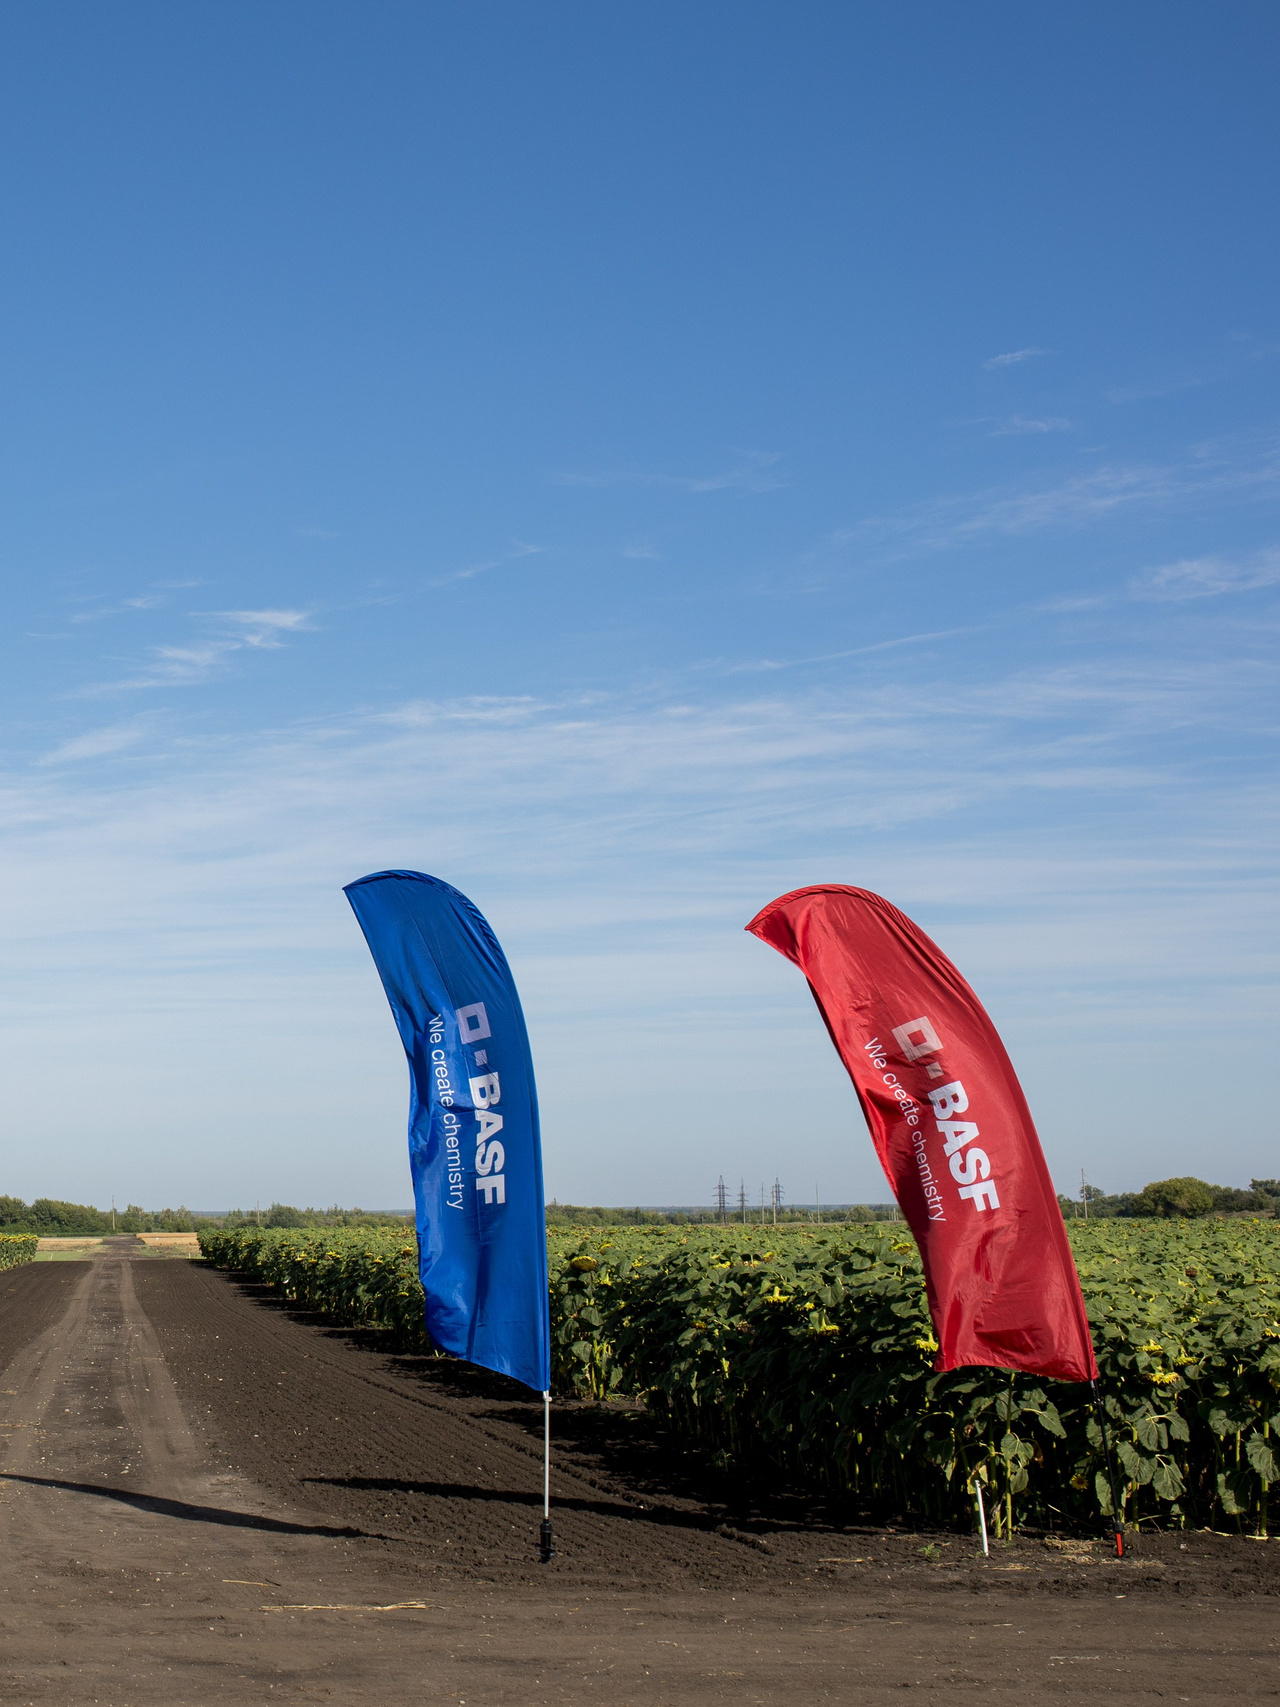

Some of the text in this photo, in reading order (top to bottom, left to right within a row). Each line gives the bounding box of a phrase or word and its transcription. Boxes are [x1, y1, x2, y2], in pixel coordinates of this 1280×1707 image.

[429, 1014, 464, 1210] We create chemistry
[469, 1071, 506, 1205] BASF
[864, 1037, 947, 1222] We create chemistry
[927, 1080, 1001, 1212] BASF
